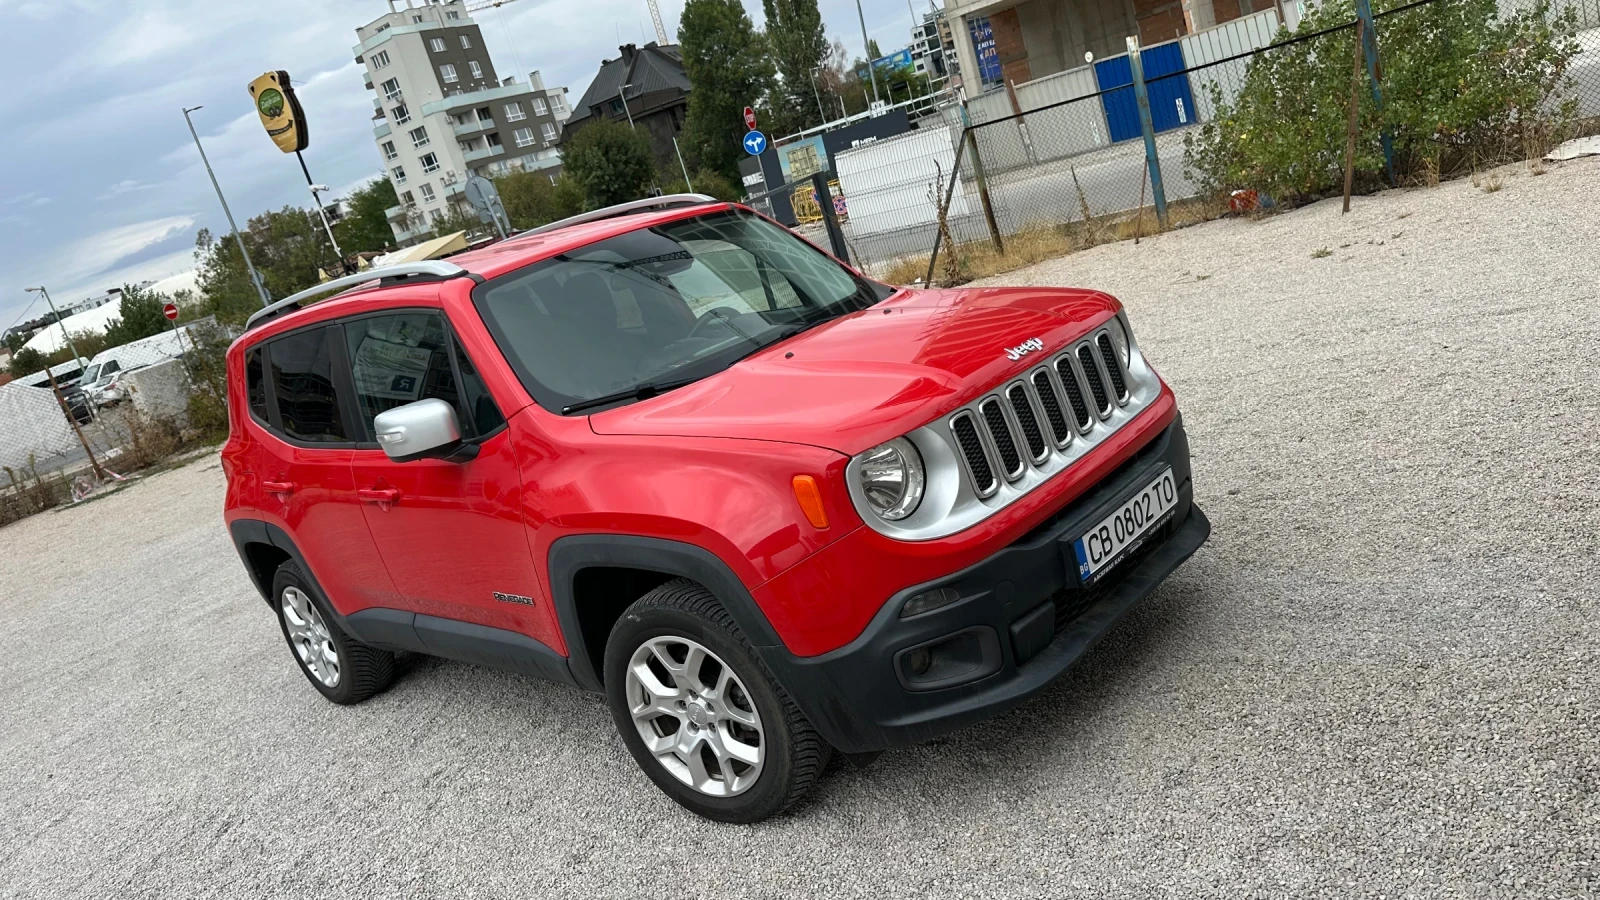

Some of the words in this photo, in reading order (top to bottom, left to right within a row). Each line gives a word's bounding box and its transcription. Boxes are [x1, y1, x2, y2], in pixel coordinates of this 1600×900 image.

[1003, 337, 1043, 360] Jeep
[1088, 525, 1113, 565] CB
[1114, 492, 1154, 544] 0802
[1151, 475, 1174, 511] TO
[1079, 562, 1089, 575] BG
[492, 591, 535, 607] RENEGADE
